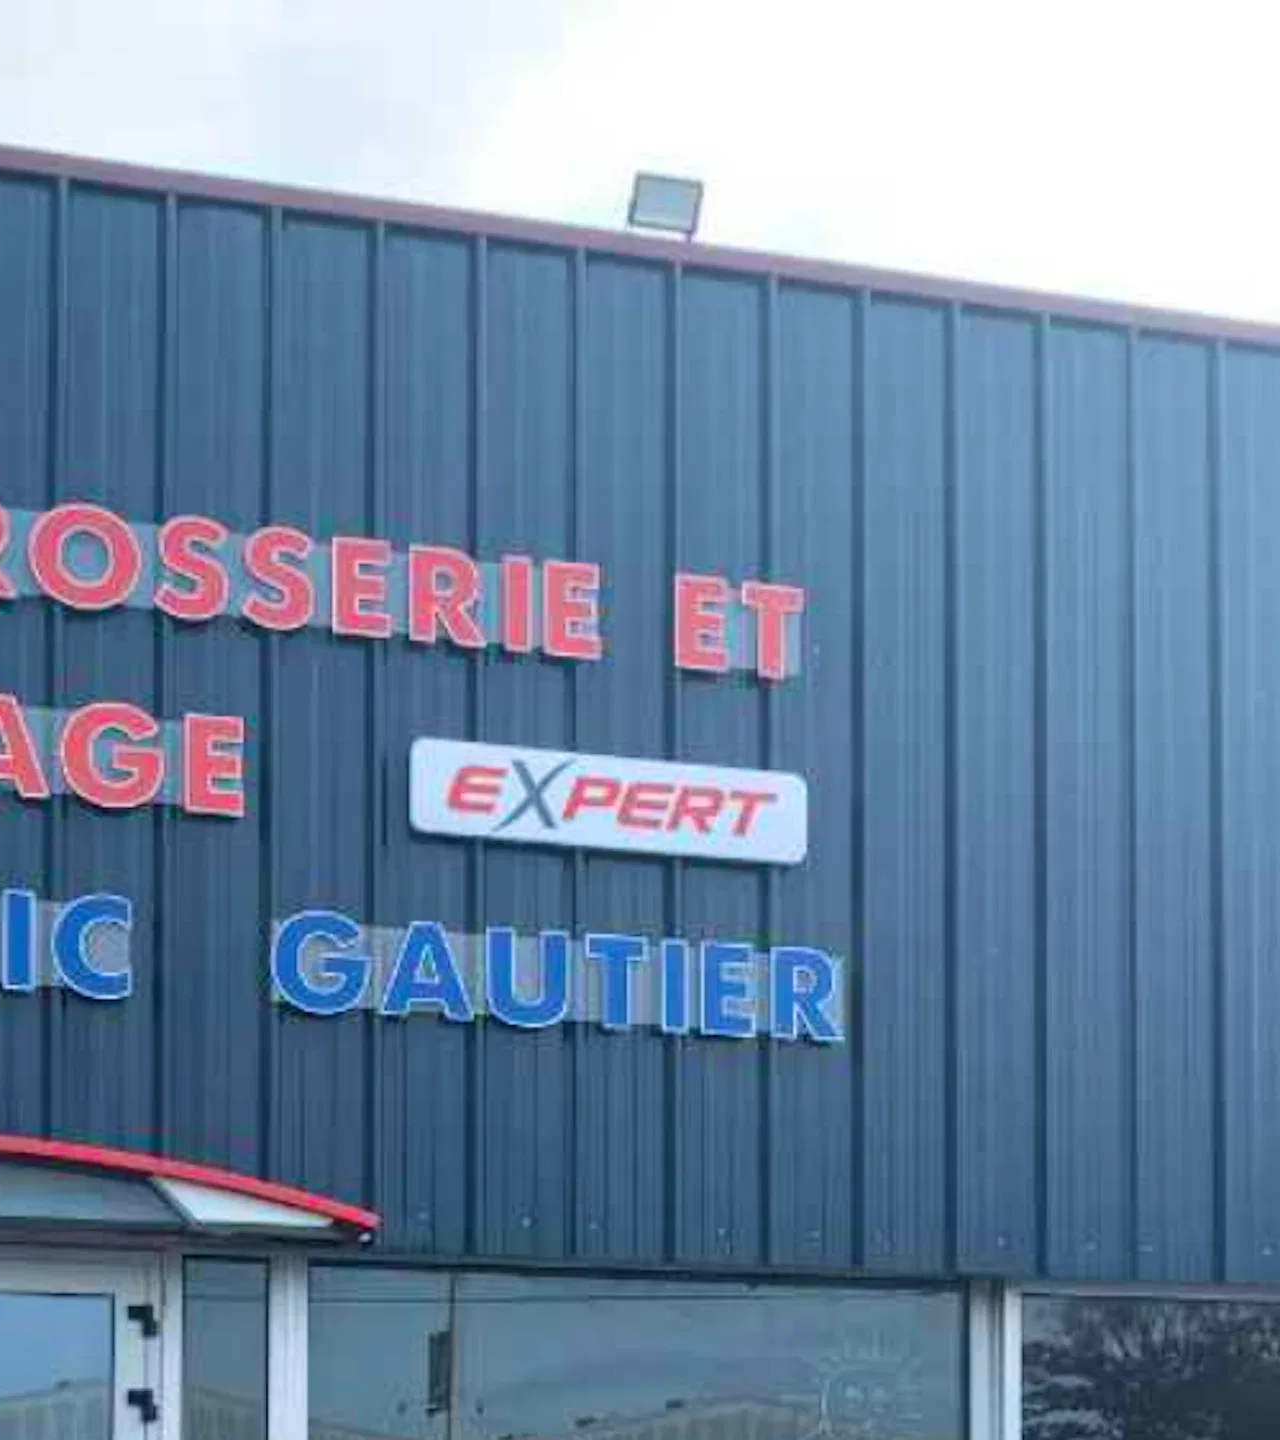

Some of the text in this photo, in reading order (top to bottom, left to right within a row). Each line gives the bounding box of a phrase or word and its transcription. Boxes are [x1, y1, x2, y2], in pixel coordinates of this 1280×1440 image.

[674, 572, 806, 681] ET
[446, 758, 779, 837] EXPERT
[270, 910, 845, 1042] GAUTIER
